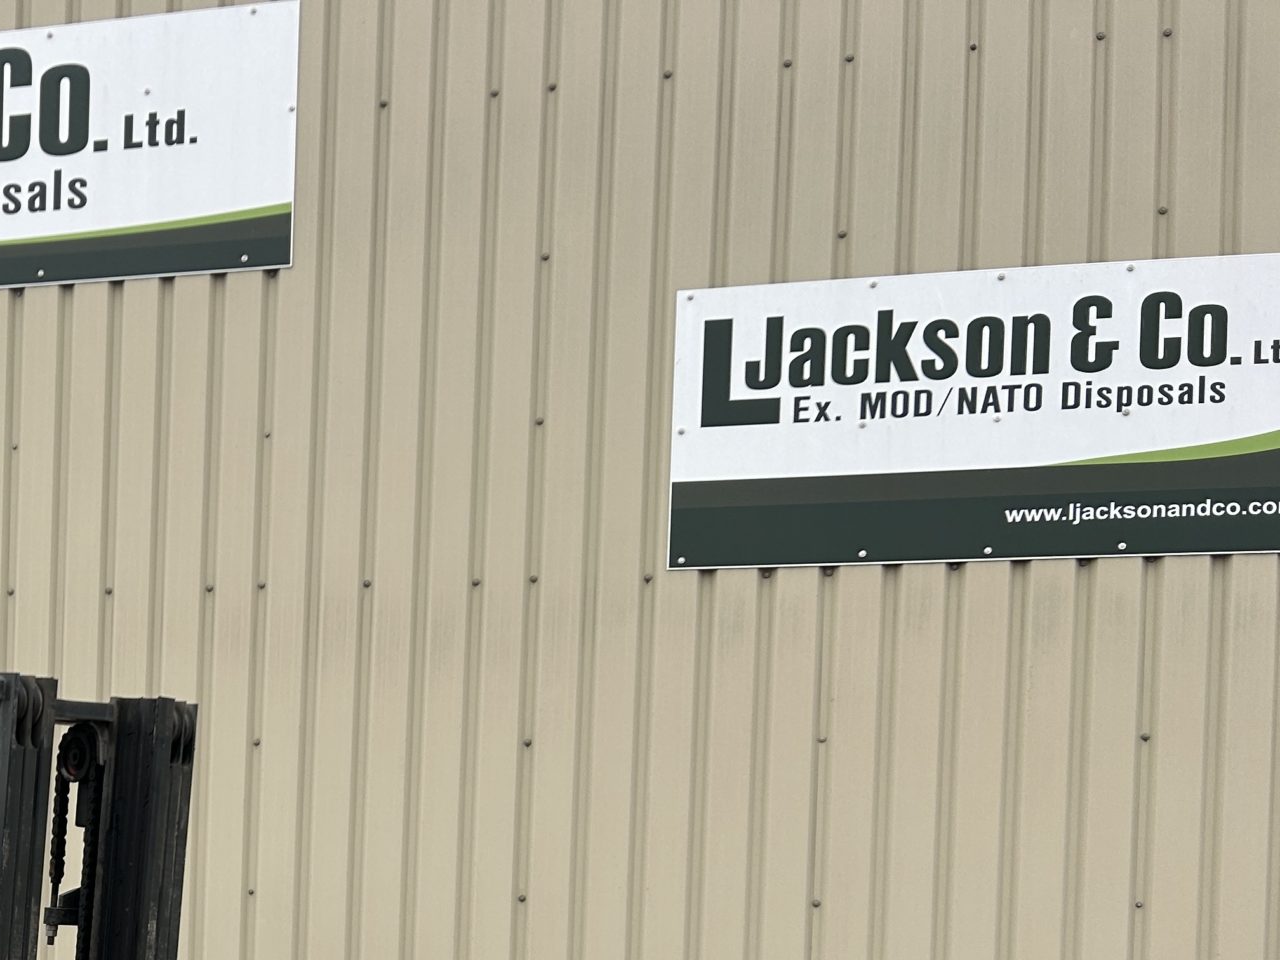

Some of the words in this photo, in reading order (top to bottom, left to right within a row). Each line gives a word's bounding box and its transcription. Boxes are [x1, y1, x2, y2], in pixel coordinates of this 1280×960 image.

[122, 109, 197, 150] Ltd.
[1070, 295, 1119, 373] &
[1139, 291, 1242, 369] Co.
[793, 395, 842, 423] Ex.
[859, 383, 1043, 420] MOD/NATO
[1061, 375, 1227, 413] Disposals
[1005, 498, 1280, 525] www.ljacksonandco.co
